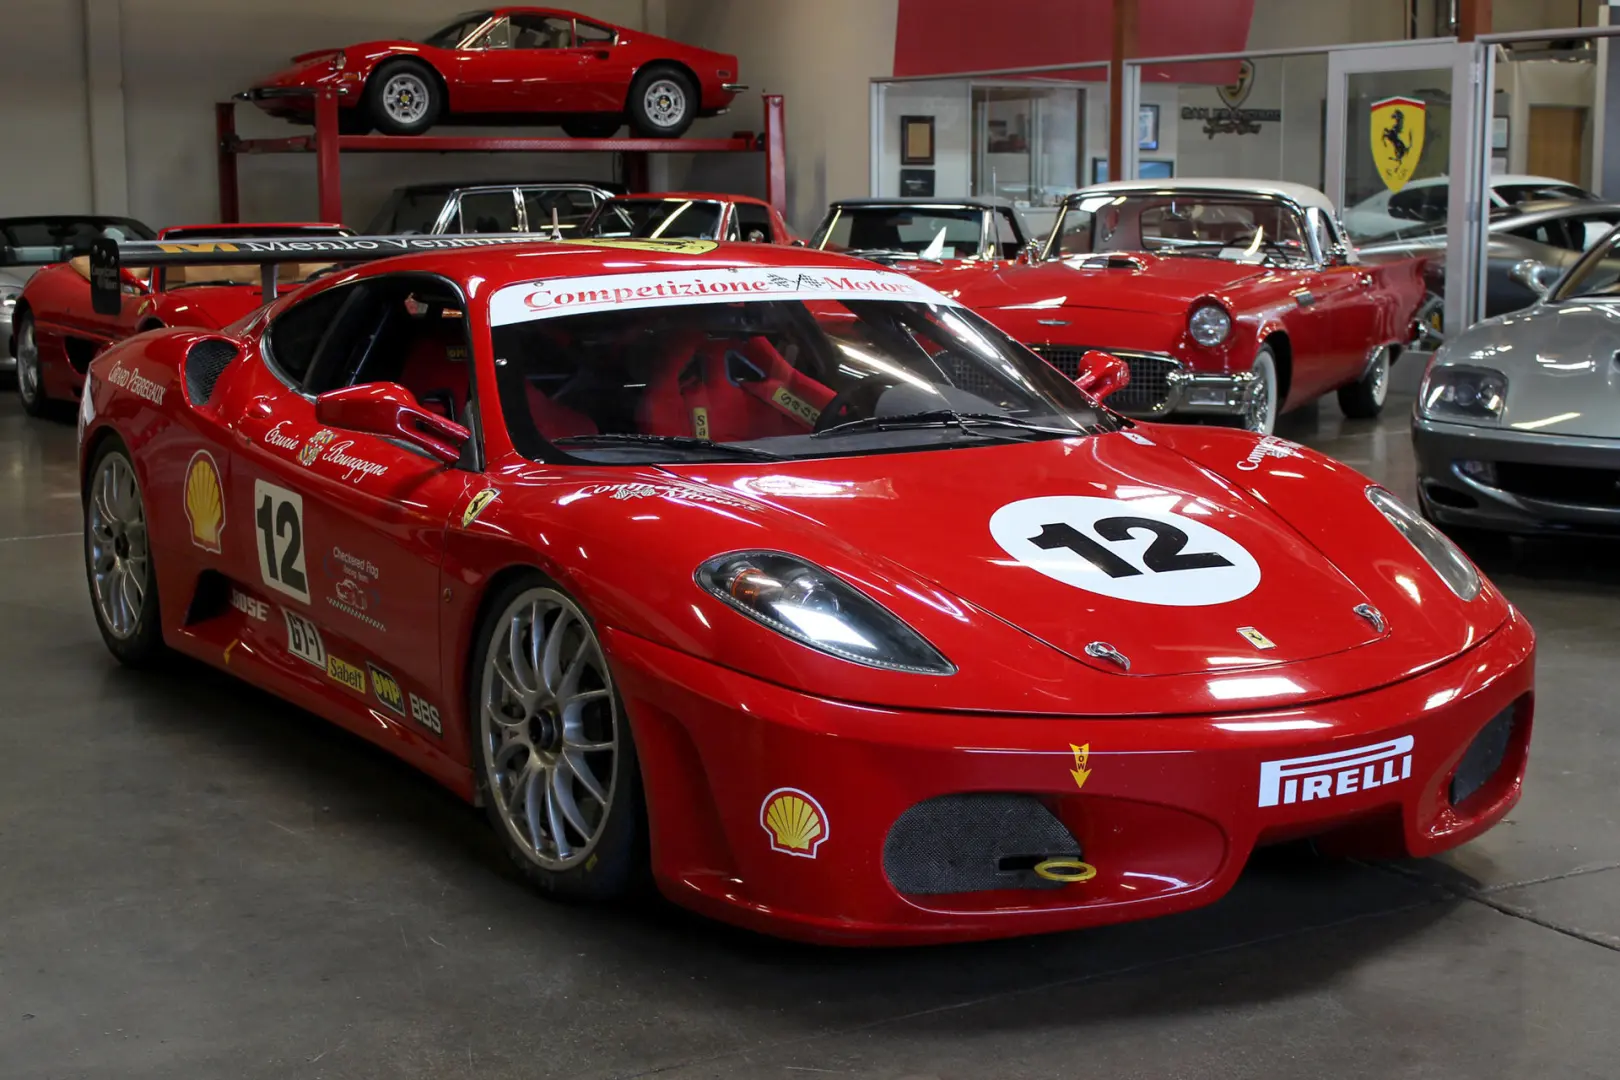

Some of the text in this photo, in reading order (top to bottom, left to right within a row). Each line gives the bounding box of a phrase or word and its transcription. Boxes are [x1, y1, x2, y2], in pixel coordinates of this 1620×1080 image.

[244, 239, 379, 252] Menlo
[523, 276, 914, 308] Competizione Motors
[322, 440, 389, 483] Bourgogne
[257, 494, 307, 595] 12
[1027, 516, 1236, 579] 12
[287, 610, 321, 662] GT-1
[330, 657, 363, 690] Sabelt
[372, 669, 401, 704] OMP
[408, 692, 443, 736] BBS
[1078, 747, 1086, 770] TOW
[1257, 734, 1415, 808] PIRELLI
